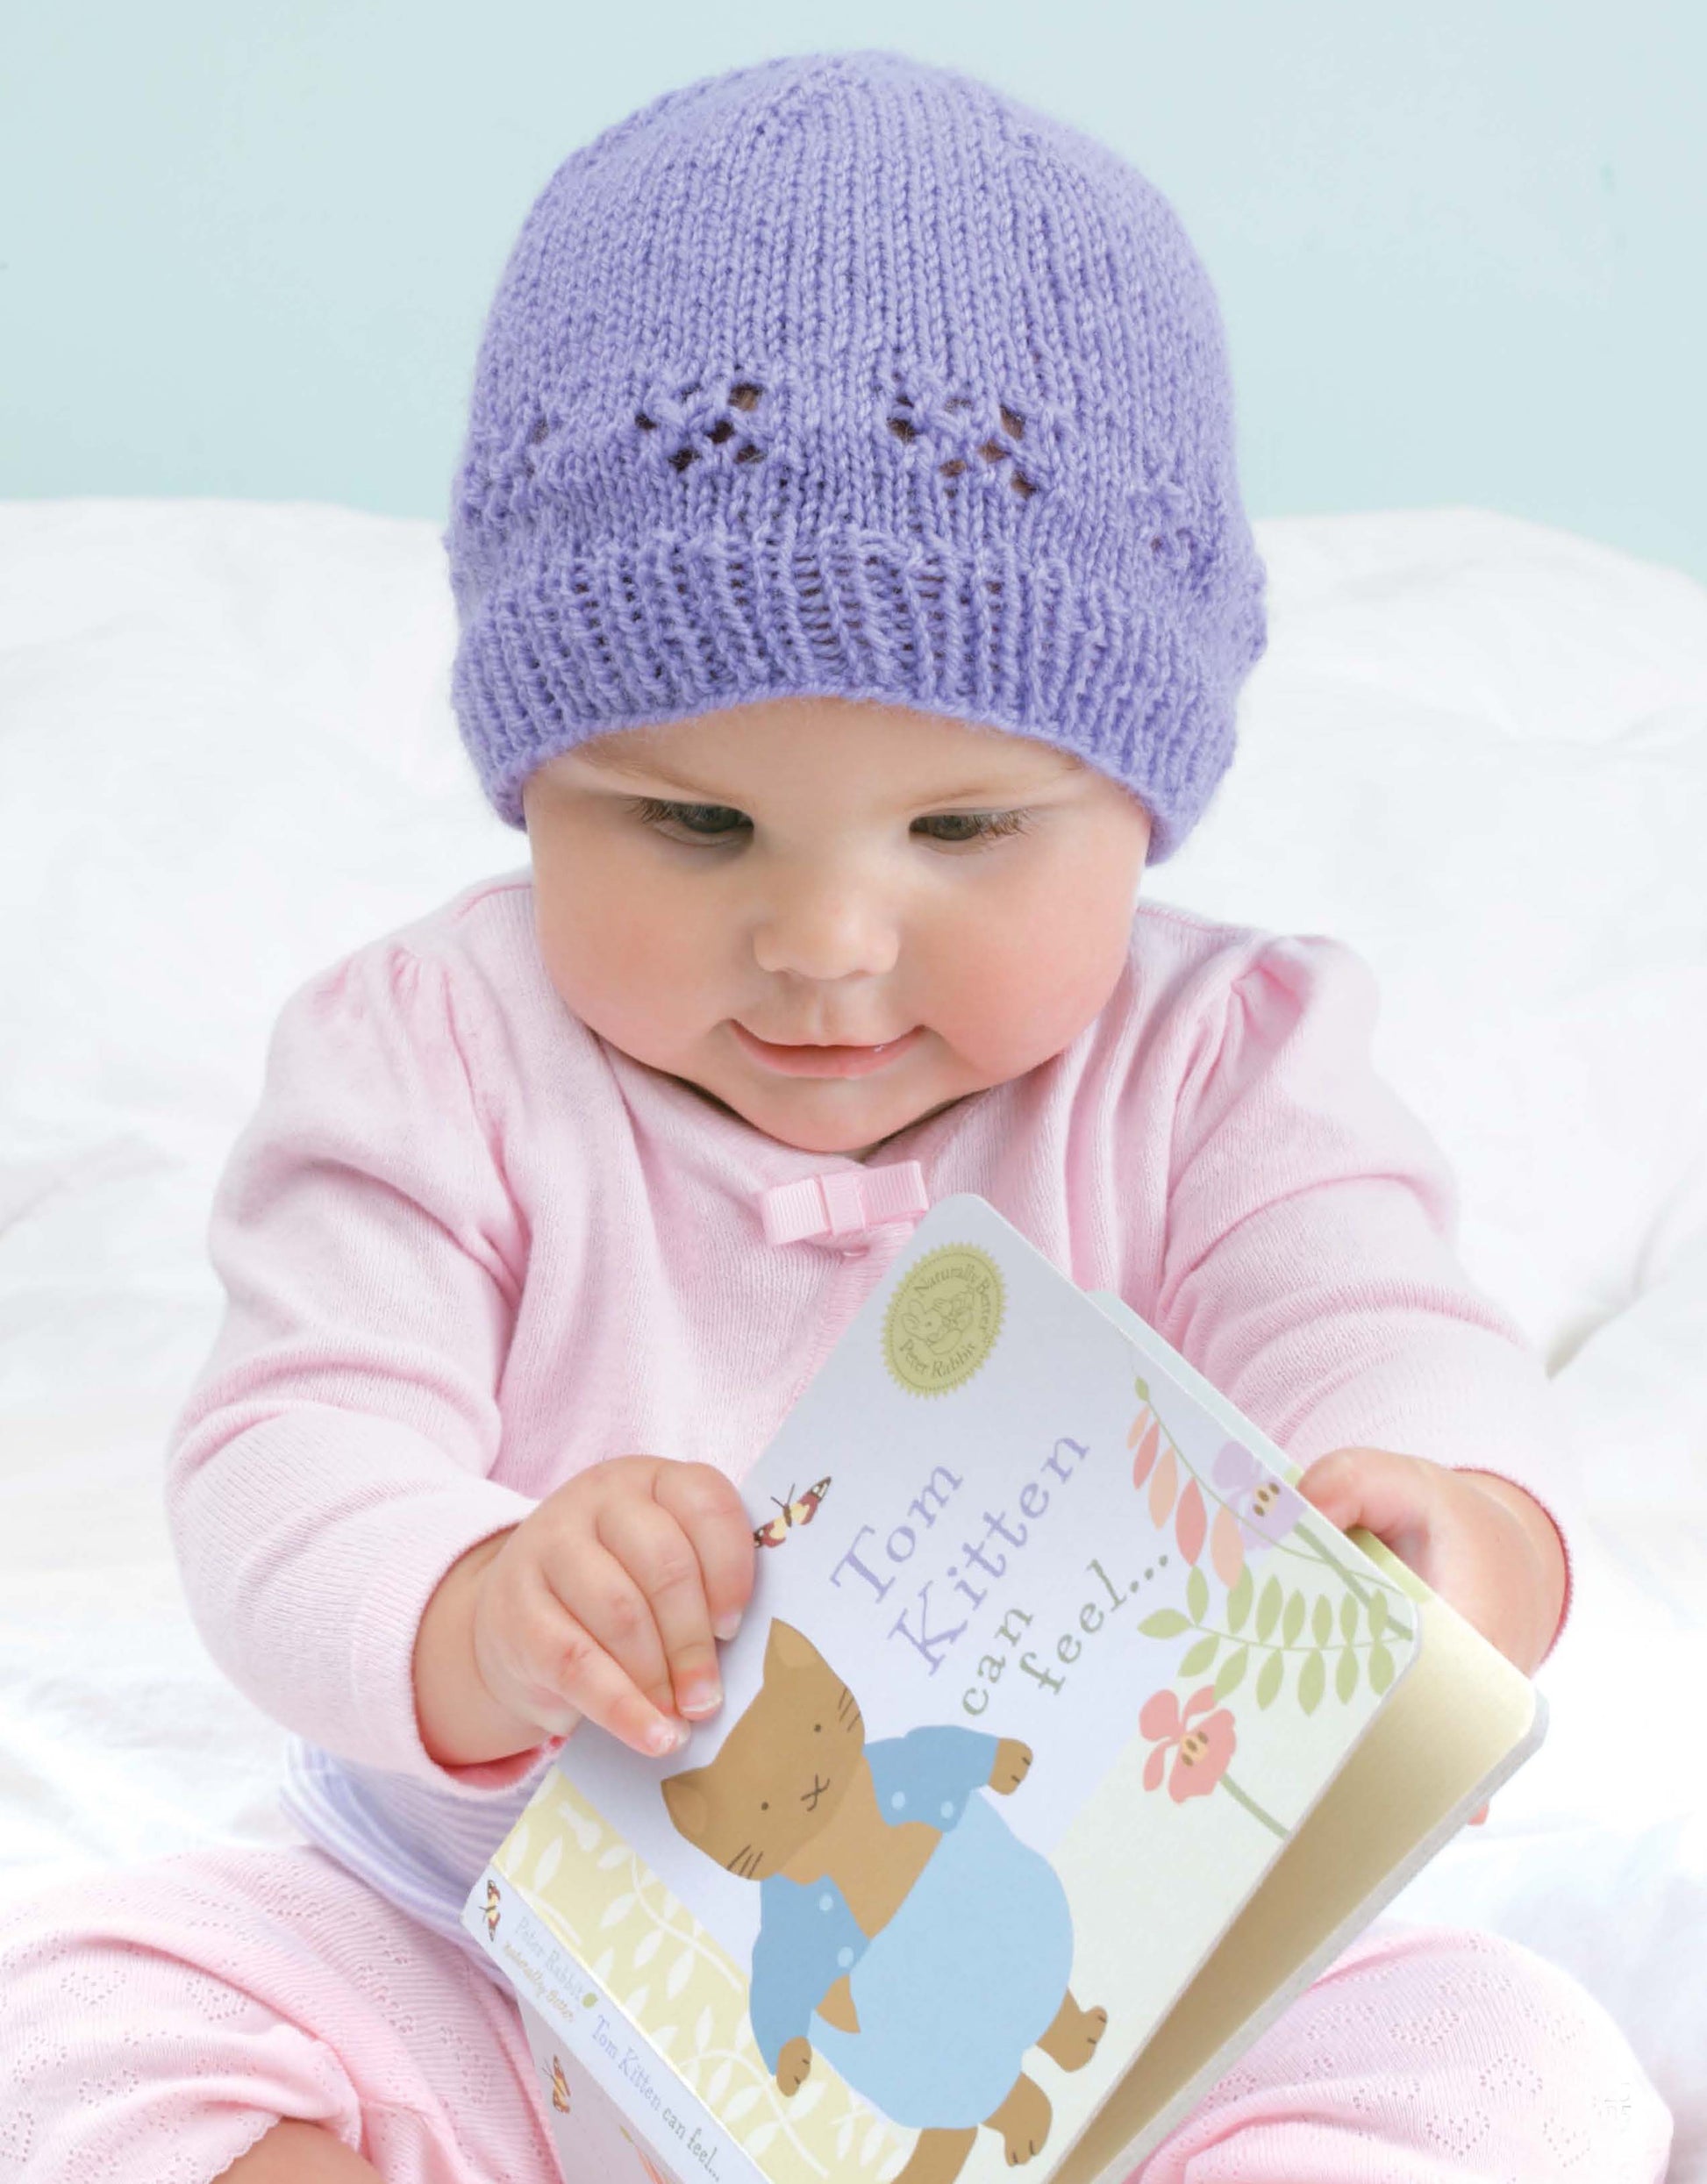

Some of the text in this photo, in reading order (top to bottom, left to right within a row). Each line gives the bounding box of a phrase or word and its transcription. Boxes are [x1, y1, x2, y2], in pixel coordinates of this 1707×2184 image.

[899, 1338, 976, 1378] Peter Rabbit
[830, 1466, 963, 1603] Tom
[888, 1437, 1090, 1676] Kitten
[962, 1606, 1033, 1716] can
[1018, 1554, 1168, 1695] feel...
[514, 1916, 583, 2001] Peter Rabbit
[591, 2014, 720, 2183] Tom Kitten can feel...
